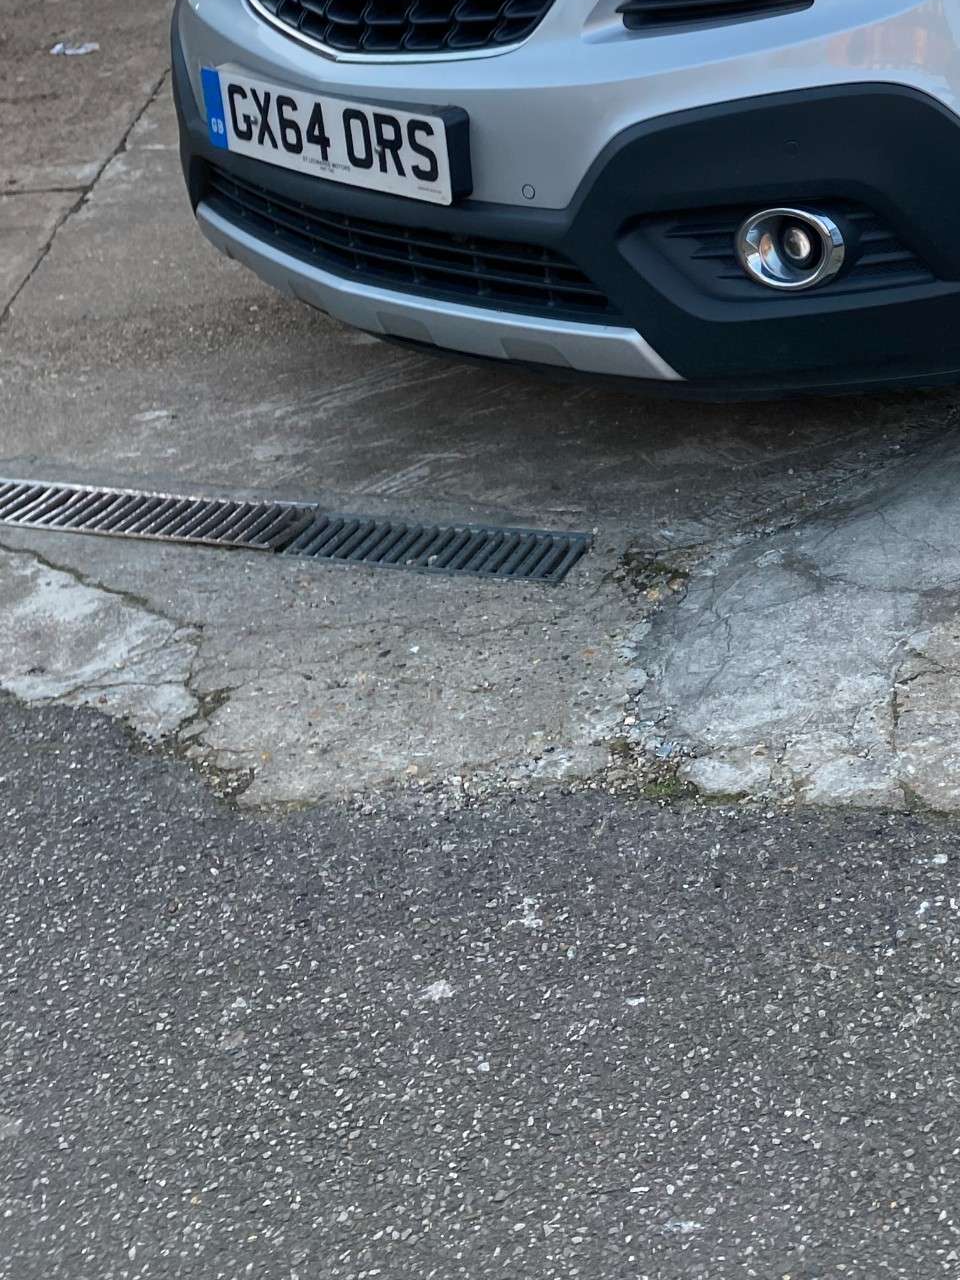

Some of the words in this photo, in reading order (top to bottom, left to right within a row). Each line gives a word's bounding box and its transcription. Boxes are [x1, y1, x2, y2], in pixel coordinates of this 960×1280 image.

[211, 117, 224, 135] GB
[227, 83, 330, 161] GX64
[343, 108, 439, 182] ORS
